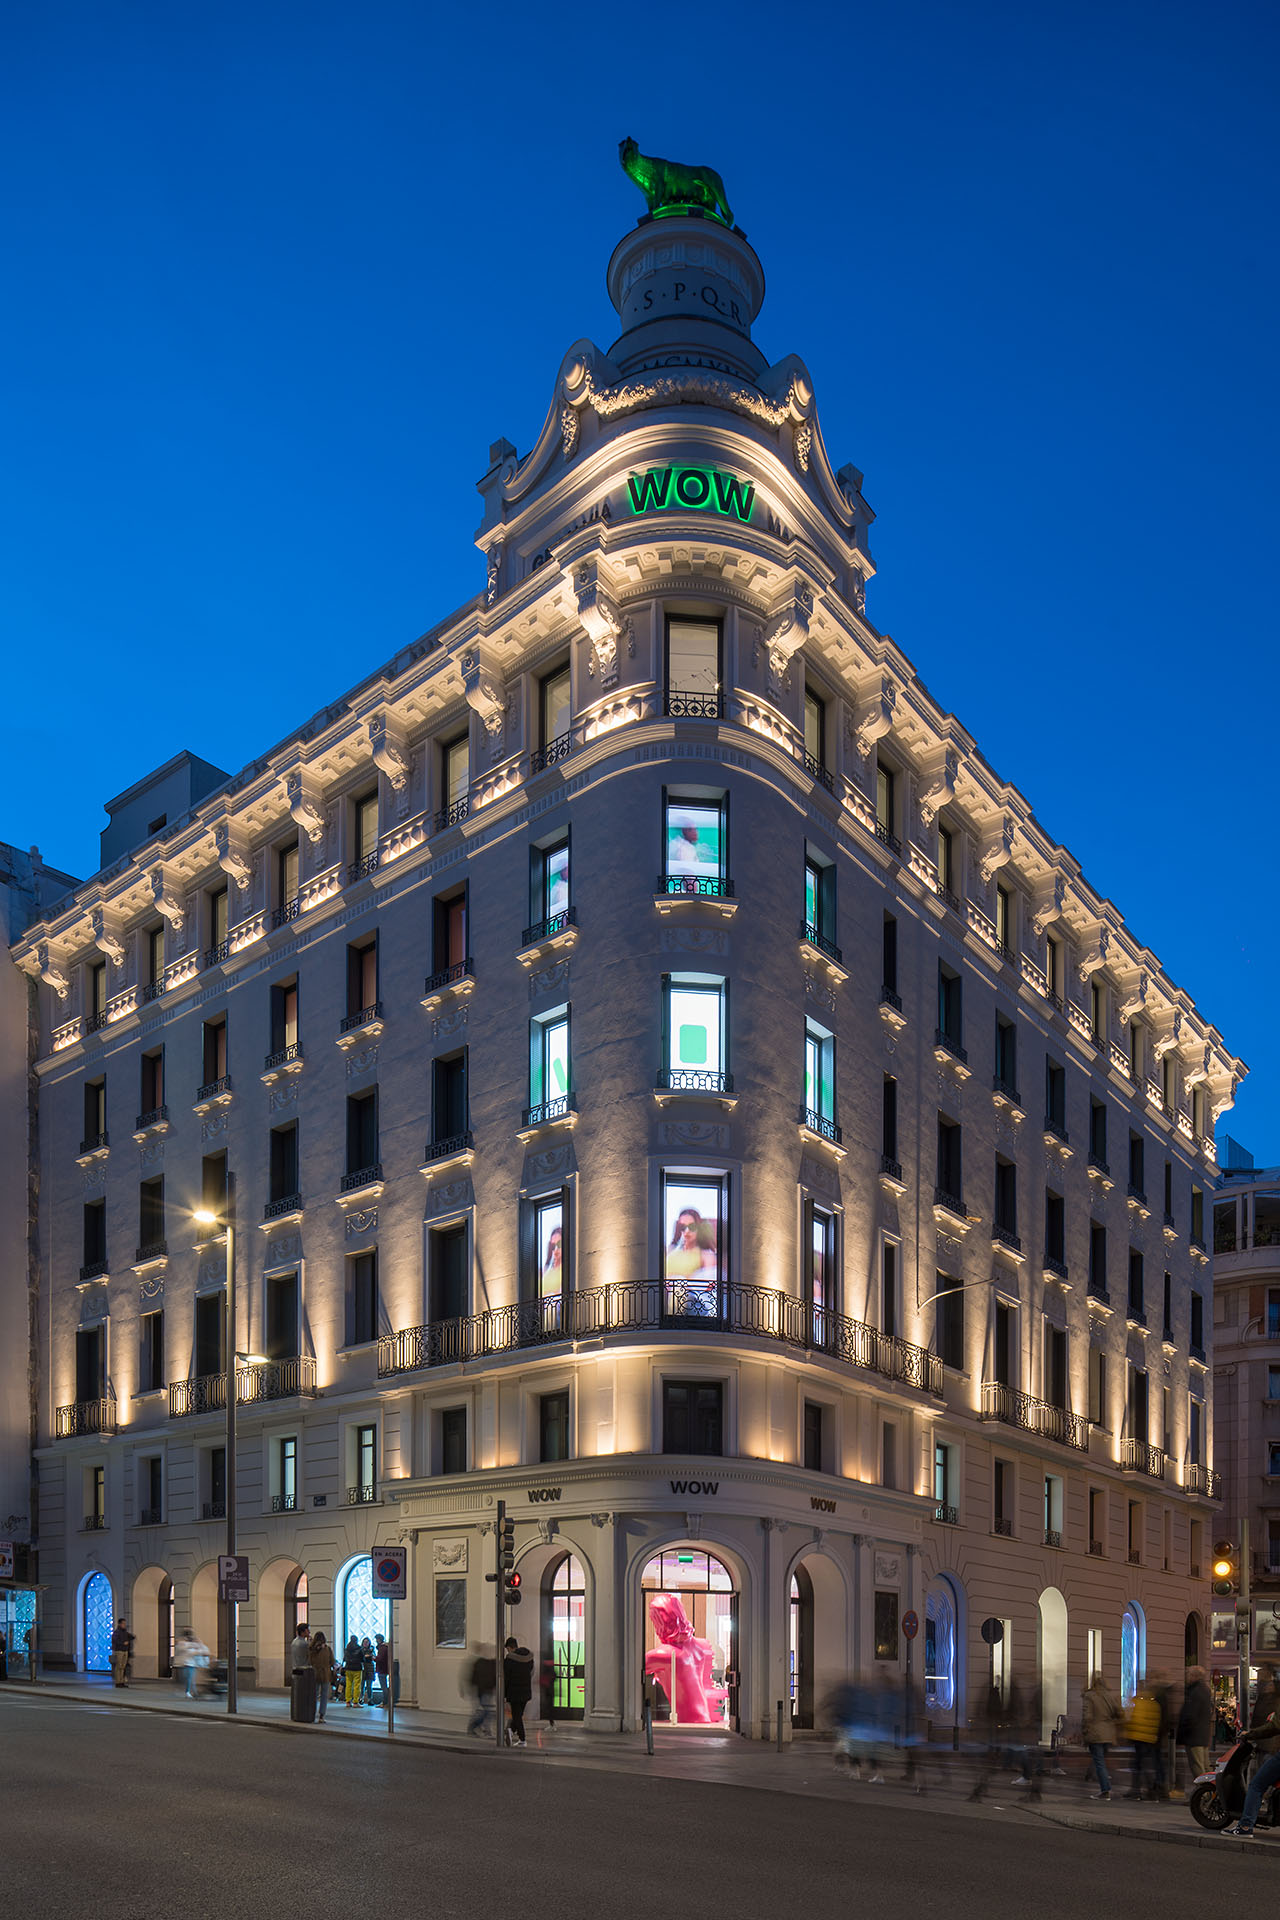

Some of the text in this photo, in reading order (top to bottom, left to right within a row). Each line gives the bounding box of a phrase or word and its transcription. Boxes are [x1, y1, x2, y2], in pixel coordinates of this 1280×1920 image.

[626, 467, 756, 522] WOW
[527, 1487, 563, 1503] WOW
[670, 1480, 720, 1496] WOW
[810, 1496, 837, 1513] WOW
[220, 1557, 238, 1580] P
